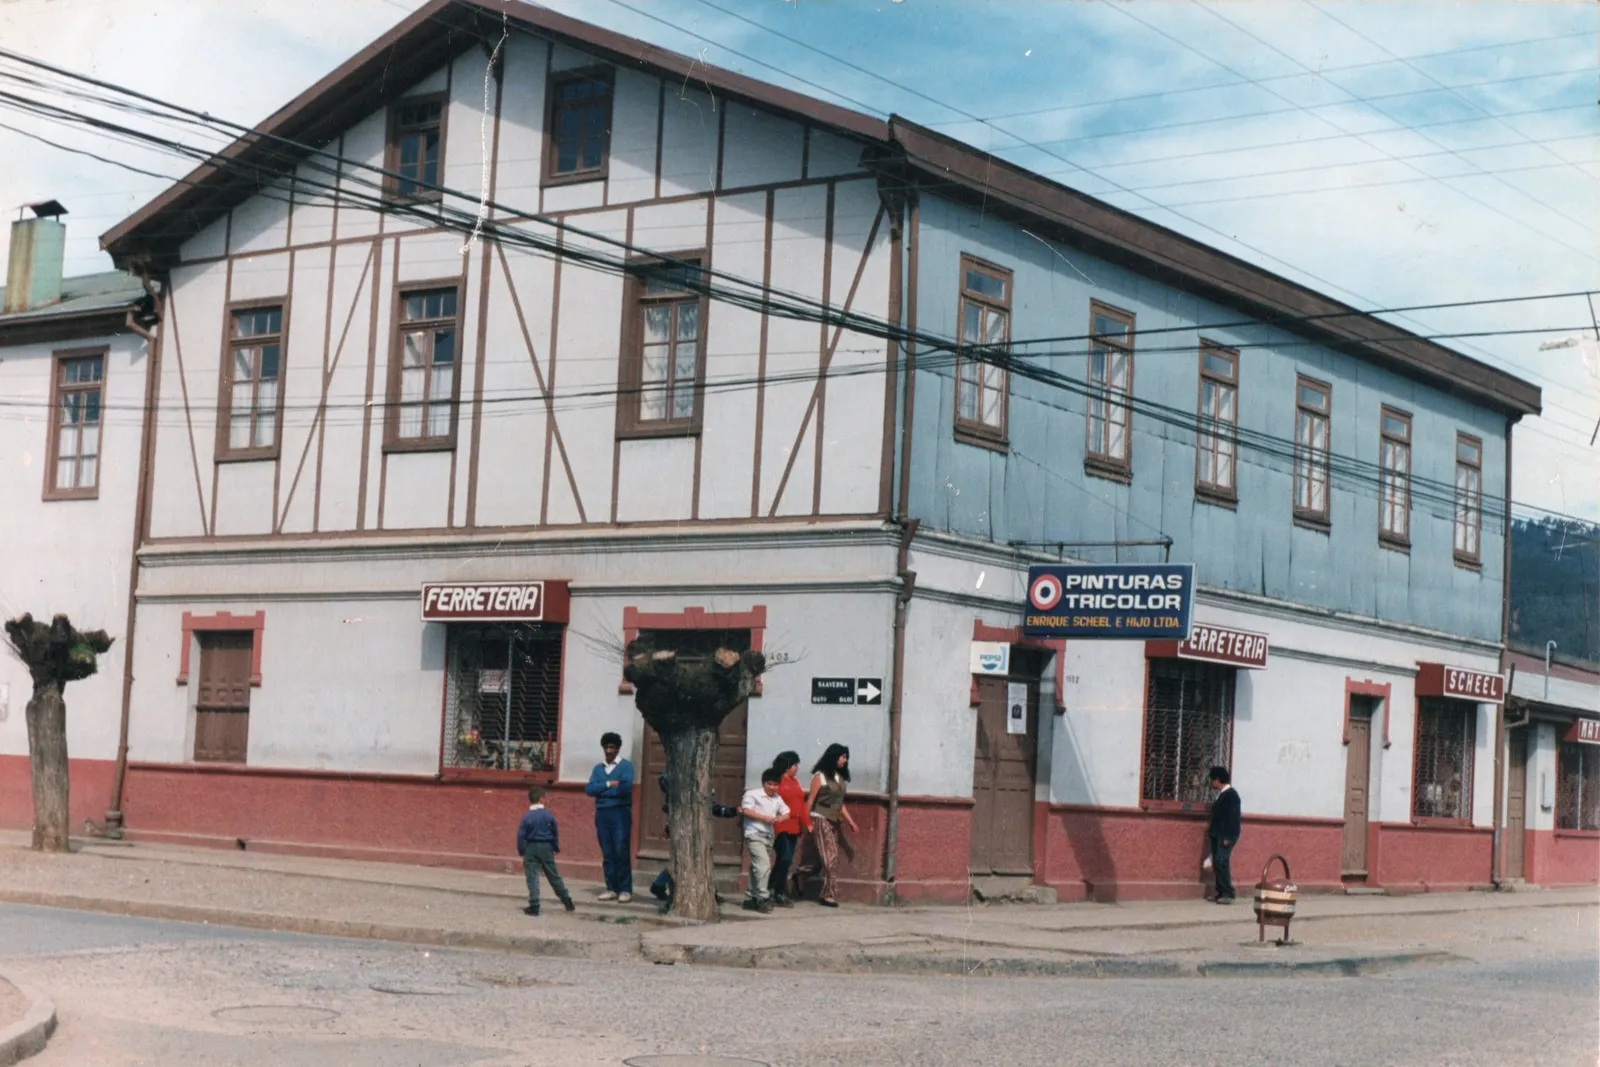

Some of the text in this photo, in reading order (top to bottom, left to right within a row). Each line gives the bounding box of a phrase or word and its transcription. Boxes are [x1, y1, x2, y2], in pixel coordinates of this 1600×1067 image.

[1066, 574, 1183, 590] PINTURAS
[425, 586, 539, 612] FERRETERIA
[1066, 594, 1181, 610] TRICOLOR
[1026, 616, 1069, 628] ENRIQUE
[1072, 616, 1111, 628] SCHEEL
[1115, 616, 1122, 628] E
[1126, 616, 1150, 628] HIJO
[1449, 670, 1498, 696] SCHEEL
